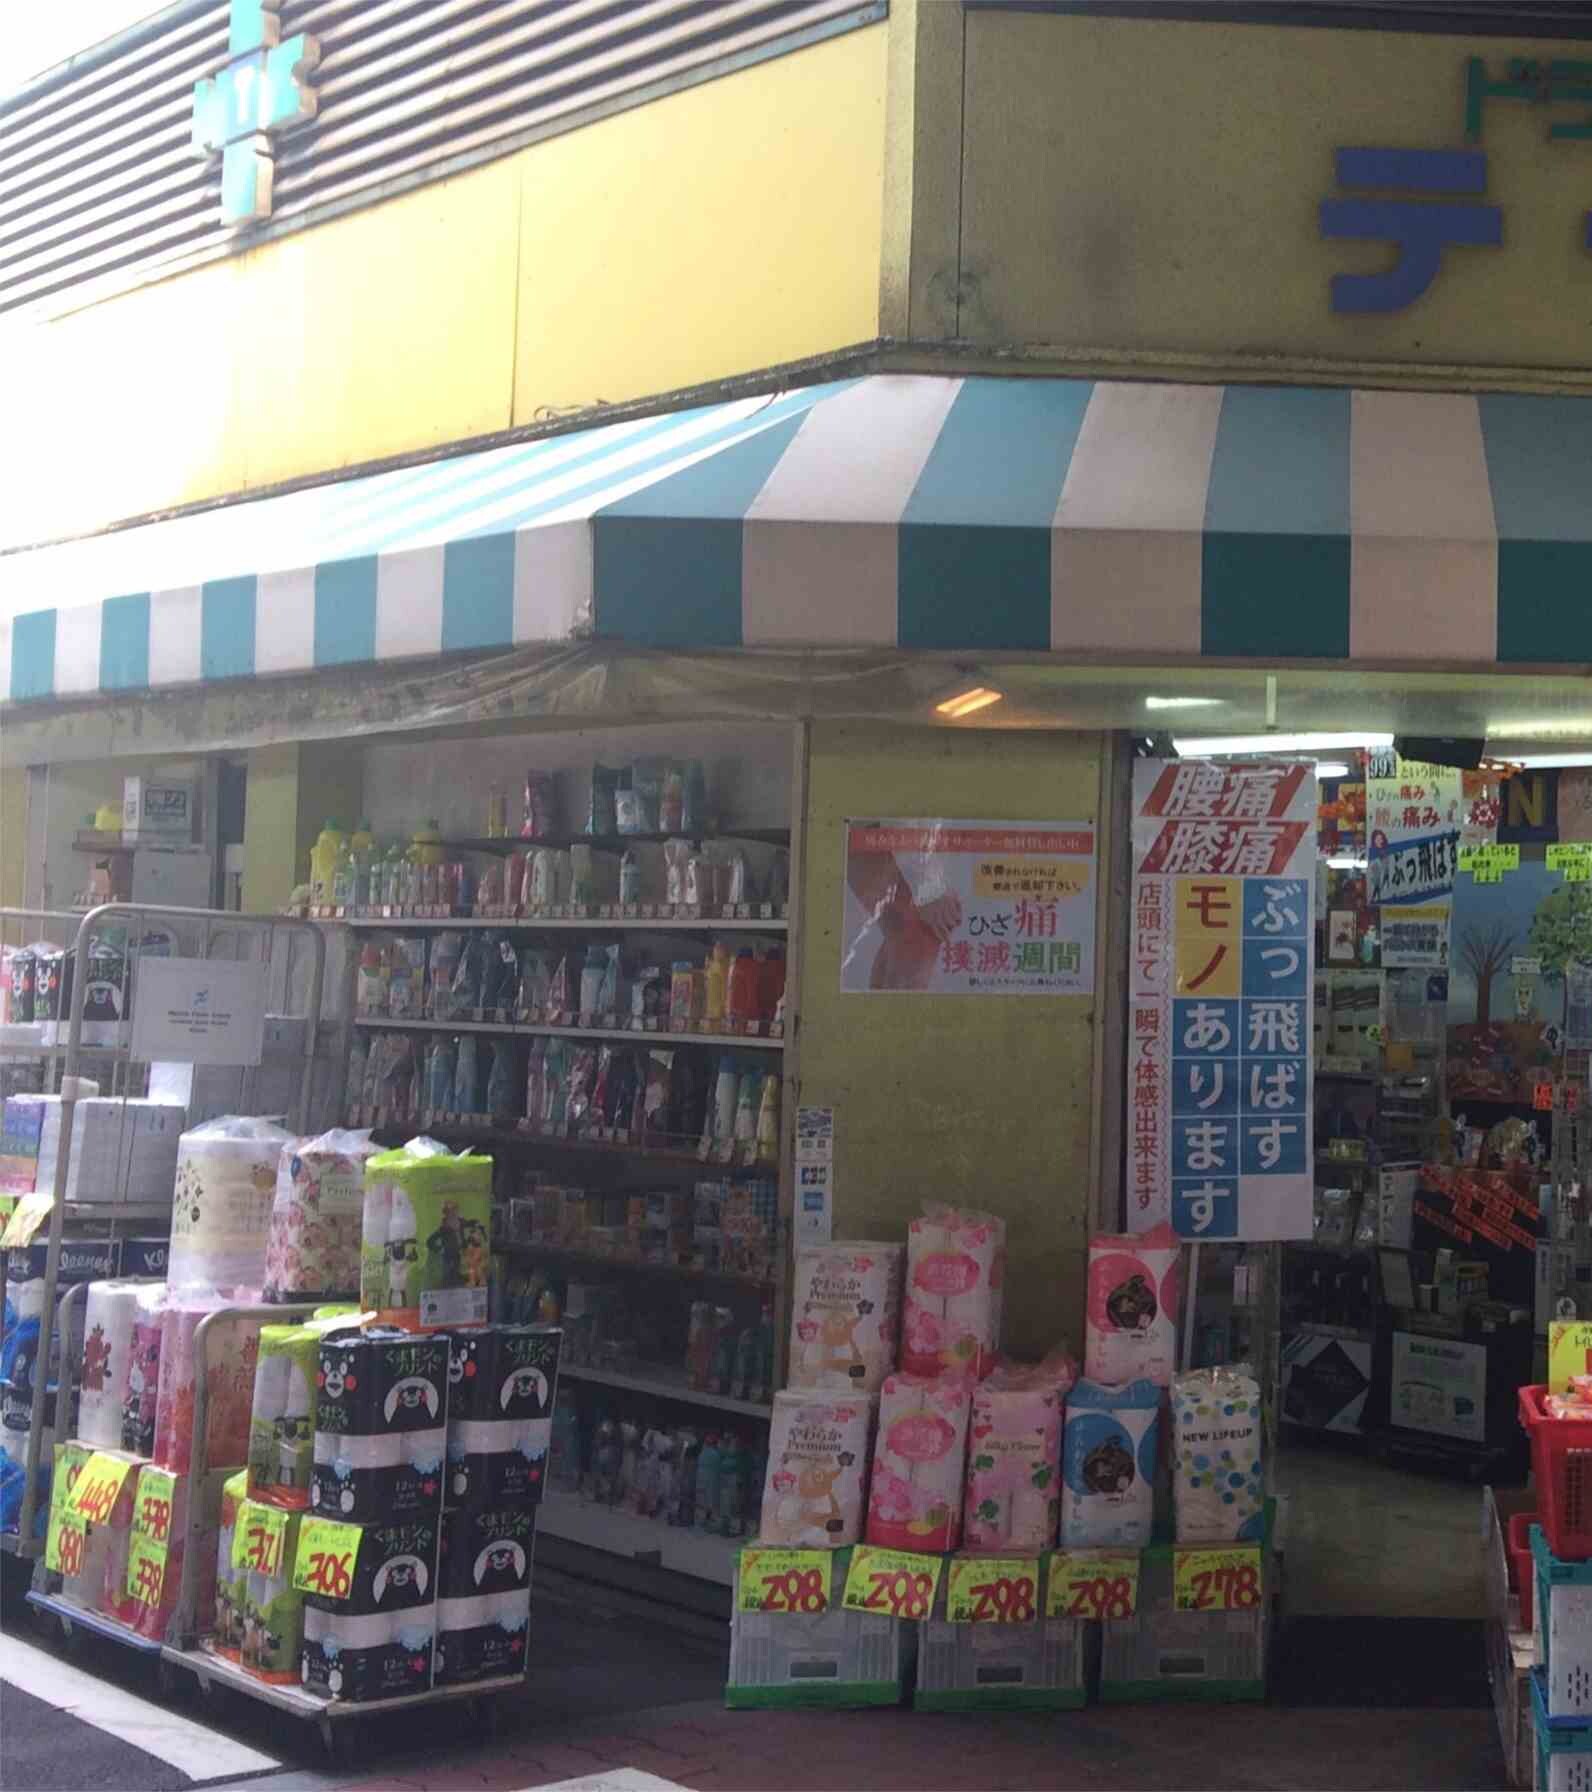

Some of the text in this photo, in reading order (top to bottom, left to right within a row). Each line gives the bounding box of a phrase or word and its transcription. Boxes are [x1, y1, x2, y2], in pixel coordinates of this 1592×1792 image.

[1160, 763, 1284, 816] 腰痛
[1159, 821, 1282, 874] 膝痛
[941, 940, 1082, 975] 撲滅週間
[1134, 881, 1164, 1211] 店頭にて一瞬で体感出来ます
[1181, 884, 1232, 1232] モノあります
[304, 1551, 353, 1598] 306
[761, 1569, 828, 1613] 298
[864, 1569, 933, 1619] 298
[1192, 1566, 1262, 1610] 278
[968, 1577, 1035, 1623] 298
[1068, 1577, 1136, 1621] 298
